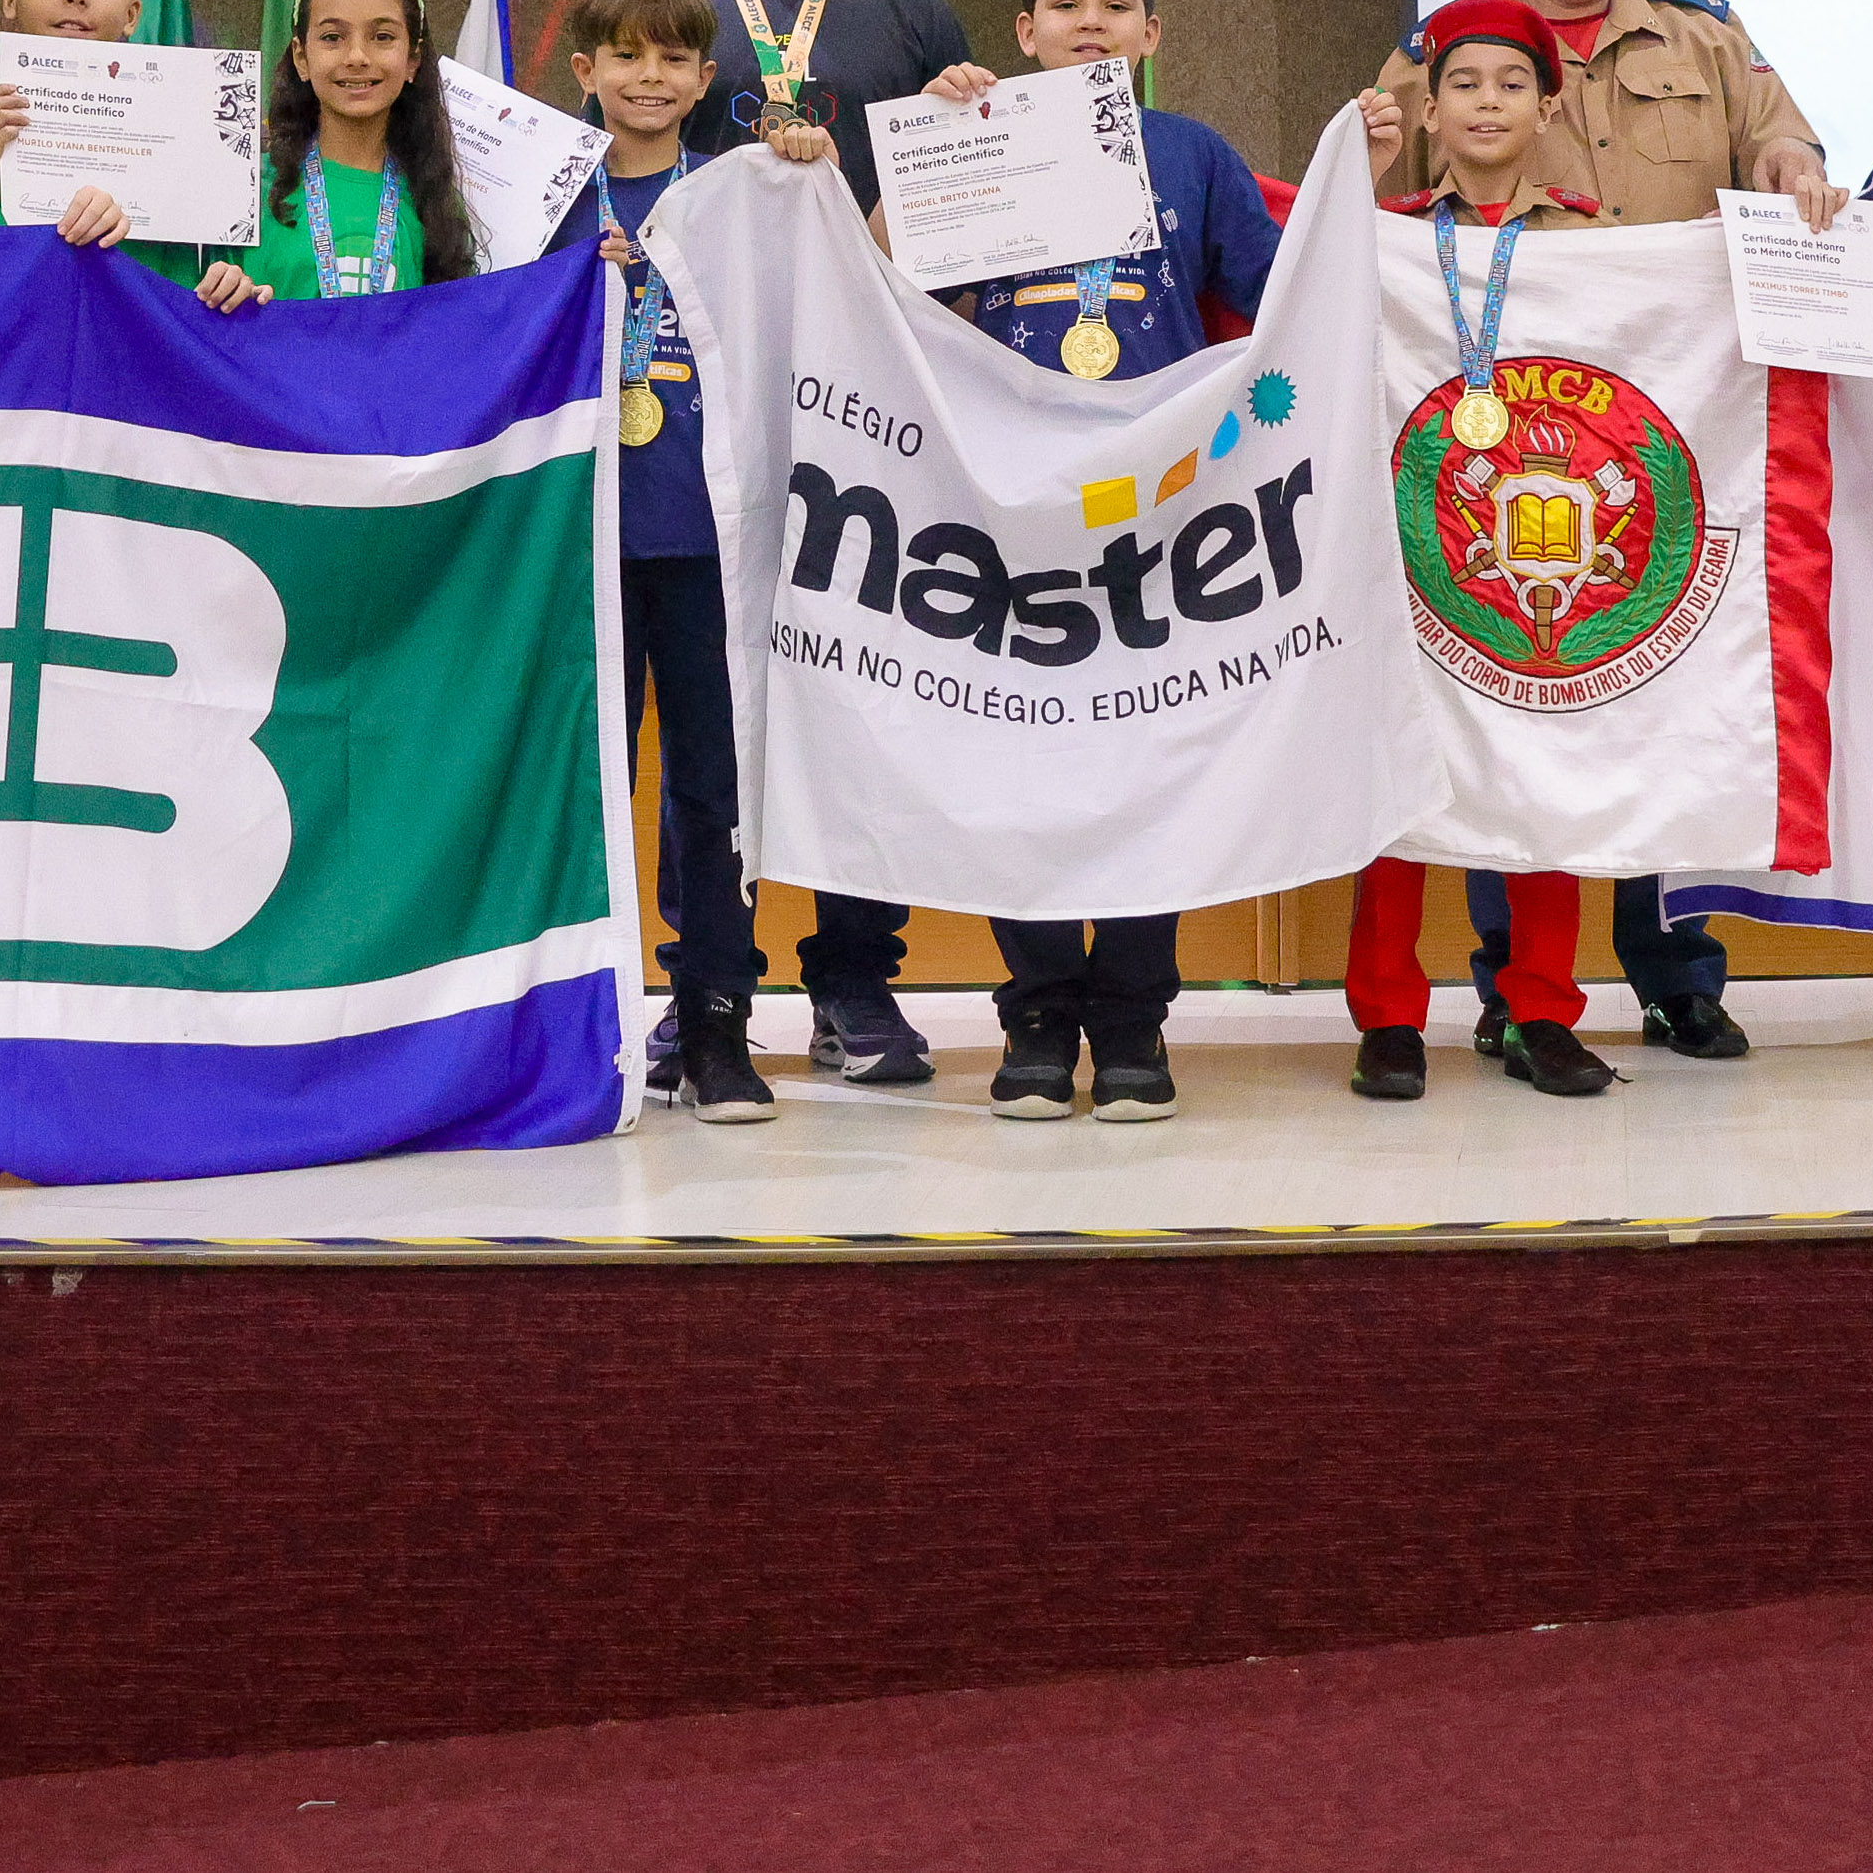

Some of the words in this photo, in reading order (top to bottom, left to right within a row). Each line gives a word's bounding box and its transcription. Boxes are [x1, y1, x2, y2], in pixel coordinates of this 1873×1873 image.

[800, 4, 818, 33] ALECE
[31, 57, 65, 69] ALECE
[16, 85, 78, 101] Certificado
[80, 91, 95, 102] de
[98, 92, 133, 106] Honra
[449, 84, 475, 101] ALECE
[33, 100, 69, 114] Mérito
[72, 104, 125, 119] Científico
[903, 114, 936, 130] ALECE
[17, 137, 54, 148] MURILO
[54, 141, 85, 152] VIANA
[454, 131, 491, 156] Científico
[466, 124, 477, 135] de
[477, 127, 503, 148] Honra
[892, 143, 955, 162] Certificado
[957, 138, 972, 150] de
[975, 131, 1010, 147] Honra
[894, 165, 910, 176] ao
[912, 157, 949, 173] Mérito
[951, 147, 1005, 166] Científico
[463, 176, 490, 194] CHAVES
[902, 197, 939, 212] MIGUEL
[940, 191, 970, 205] BRITO
[971, 185, 1002, 199] VIANA
[1751, 209, 1783, 220] ALECE
[1741, 232, 1799, 249] Certificado
[1801, 239, 1814, 249] de
[1816, 241, 1846, 254] Honra
[1743, 247, 1758, 256] ao
[1760, 246, 1793, 259] Mérito
[1794, 250, 1841, 265] Científico
[1748, 279, 1788, 293] MAXIMUS
[1789, 284, 1821, 296] TORRES
[1492, 365, 1614, 415] MCB
[791, 372, 923, 457] OLÉGIO
[787, 457, 1314, 668] master
[1699, 535, 1732, 592] CEARÁ
[1693, 584, 1712, 619] DO
[1653, 606, 1698, 662] ESTADO
[1438, 637, 1466, 665] DO
[1626, 648, 1655, 678] DO
[857, 645, 902, 689] NO
[913, 669, 1076, 726] COLÉGIO.
[1091, 674, 1209, 723] EDUCA
[1218, 651, 1272, 691] NA
[1461, 655, 1509, 698] CORPO
[1538, 662, 1634, 707] BOMBEIROS
[1513, 680, 1534, 705] DE
